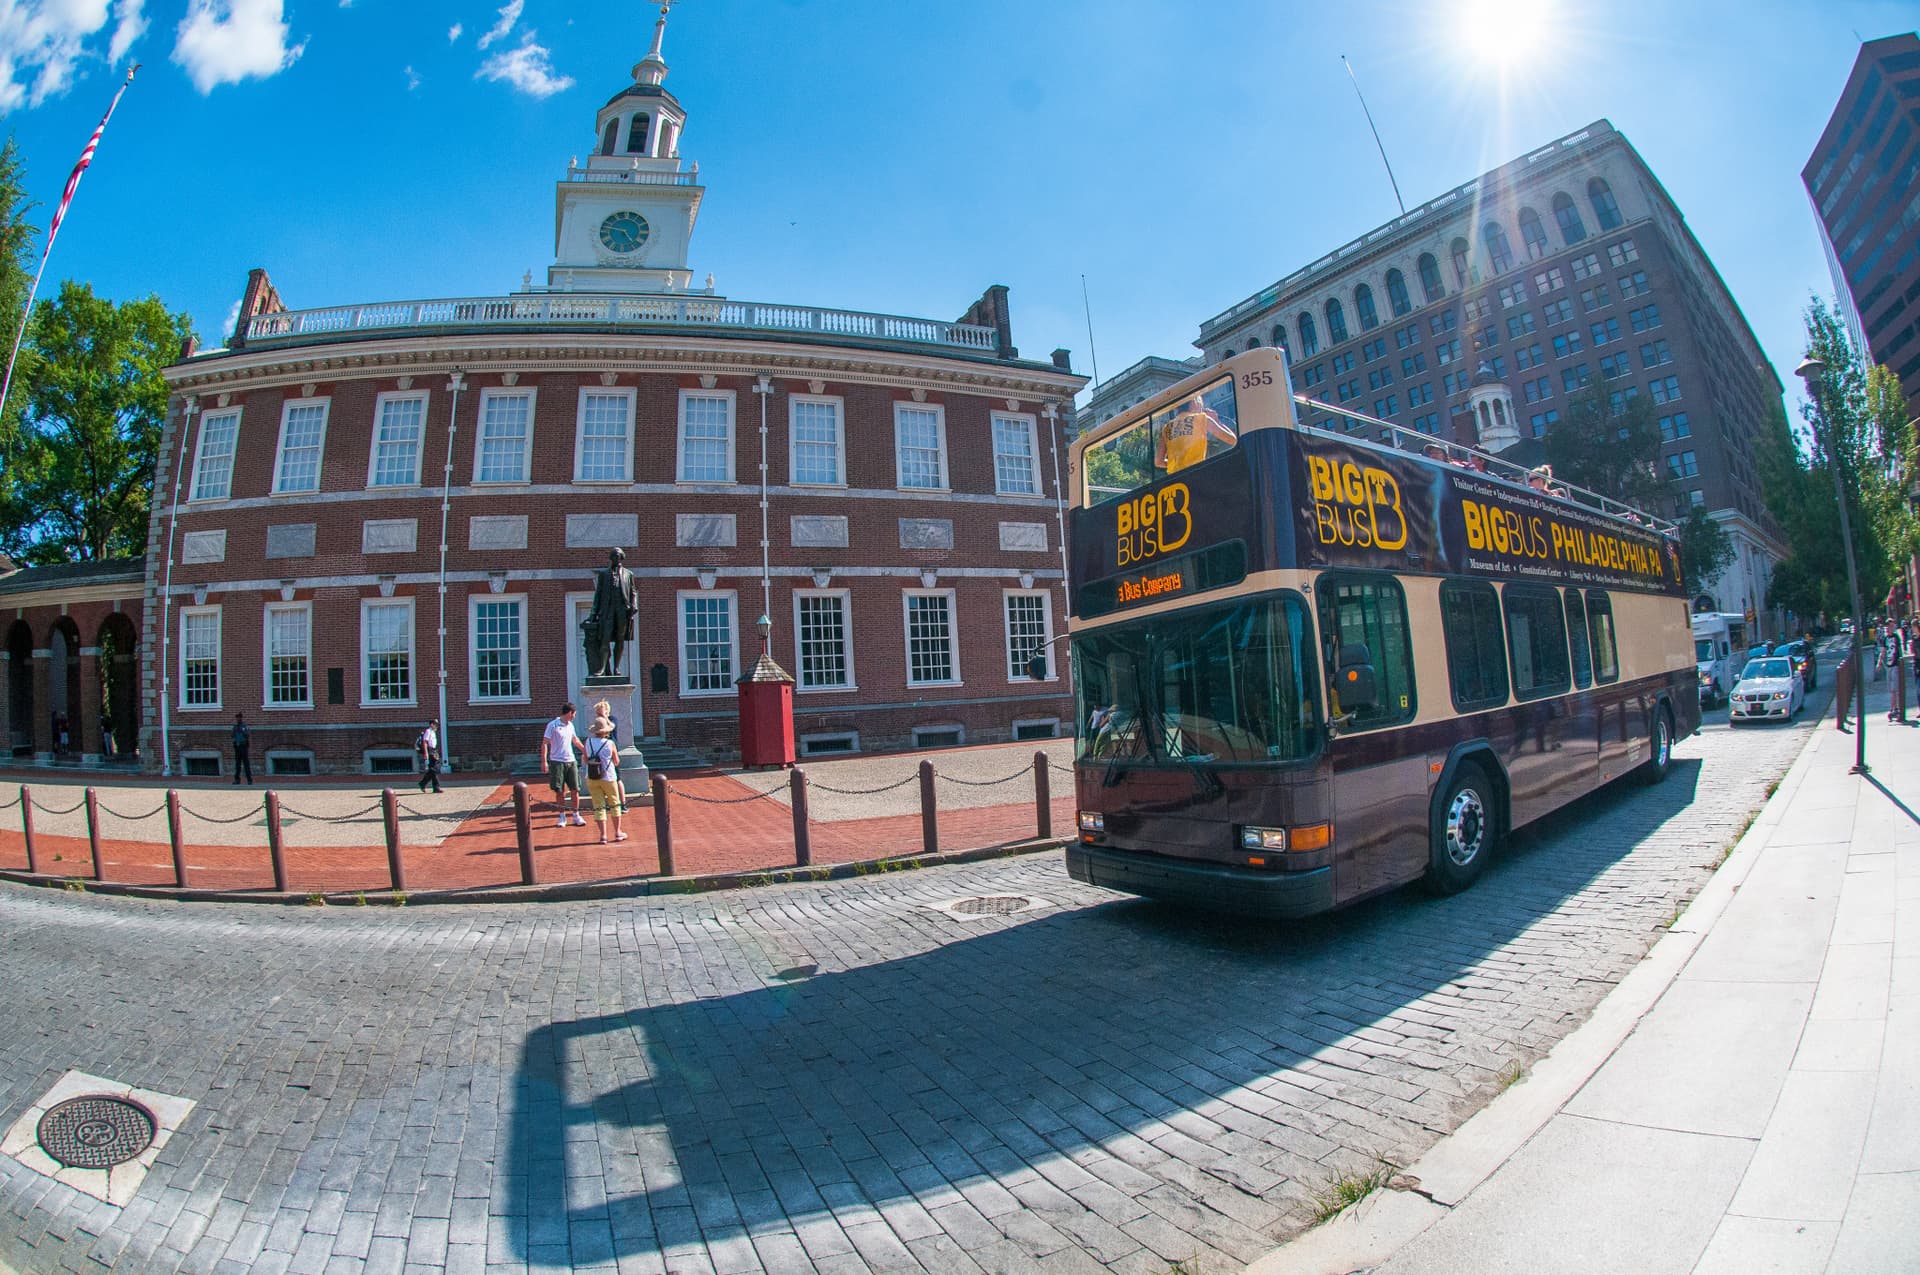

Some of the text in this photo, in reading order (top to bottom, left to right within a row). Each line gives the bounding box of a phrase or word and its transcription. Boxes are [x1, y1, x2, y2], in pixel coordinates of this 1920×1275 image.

[1242, 371, 1273, 389] 355
[1308, 455, 1364, 505] BIG
[1452, 476, 1474, 491] Visitor
[1474, 482, 1493, 496] Center
[1117, 494, 1157, 536] BIG
[1316, 503, 1372, 547] BUS
[1117, 527, 1157, 567] BUS
[1551, 522, 1648, 576] PHILADELPHIA
[1649, 547, 1664, 577] PA
[1124, 580, 1142, 601] Bus
[1141, 573, 1182, 597] Company
[1469, 558, 1494, 571] Museum
[1494, 561, 1501, 571] of
[1501, 562, 1511, 572] Art
[1519, 563, 1547, 576] Constitution
[1547, 567, 1562, 577] Center
